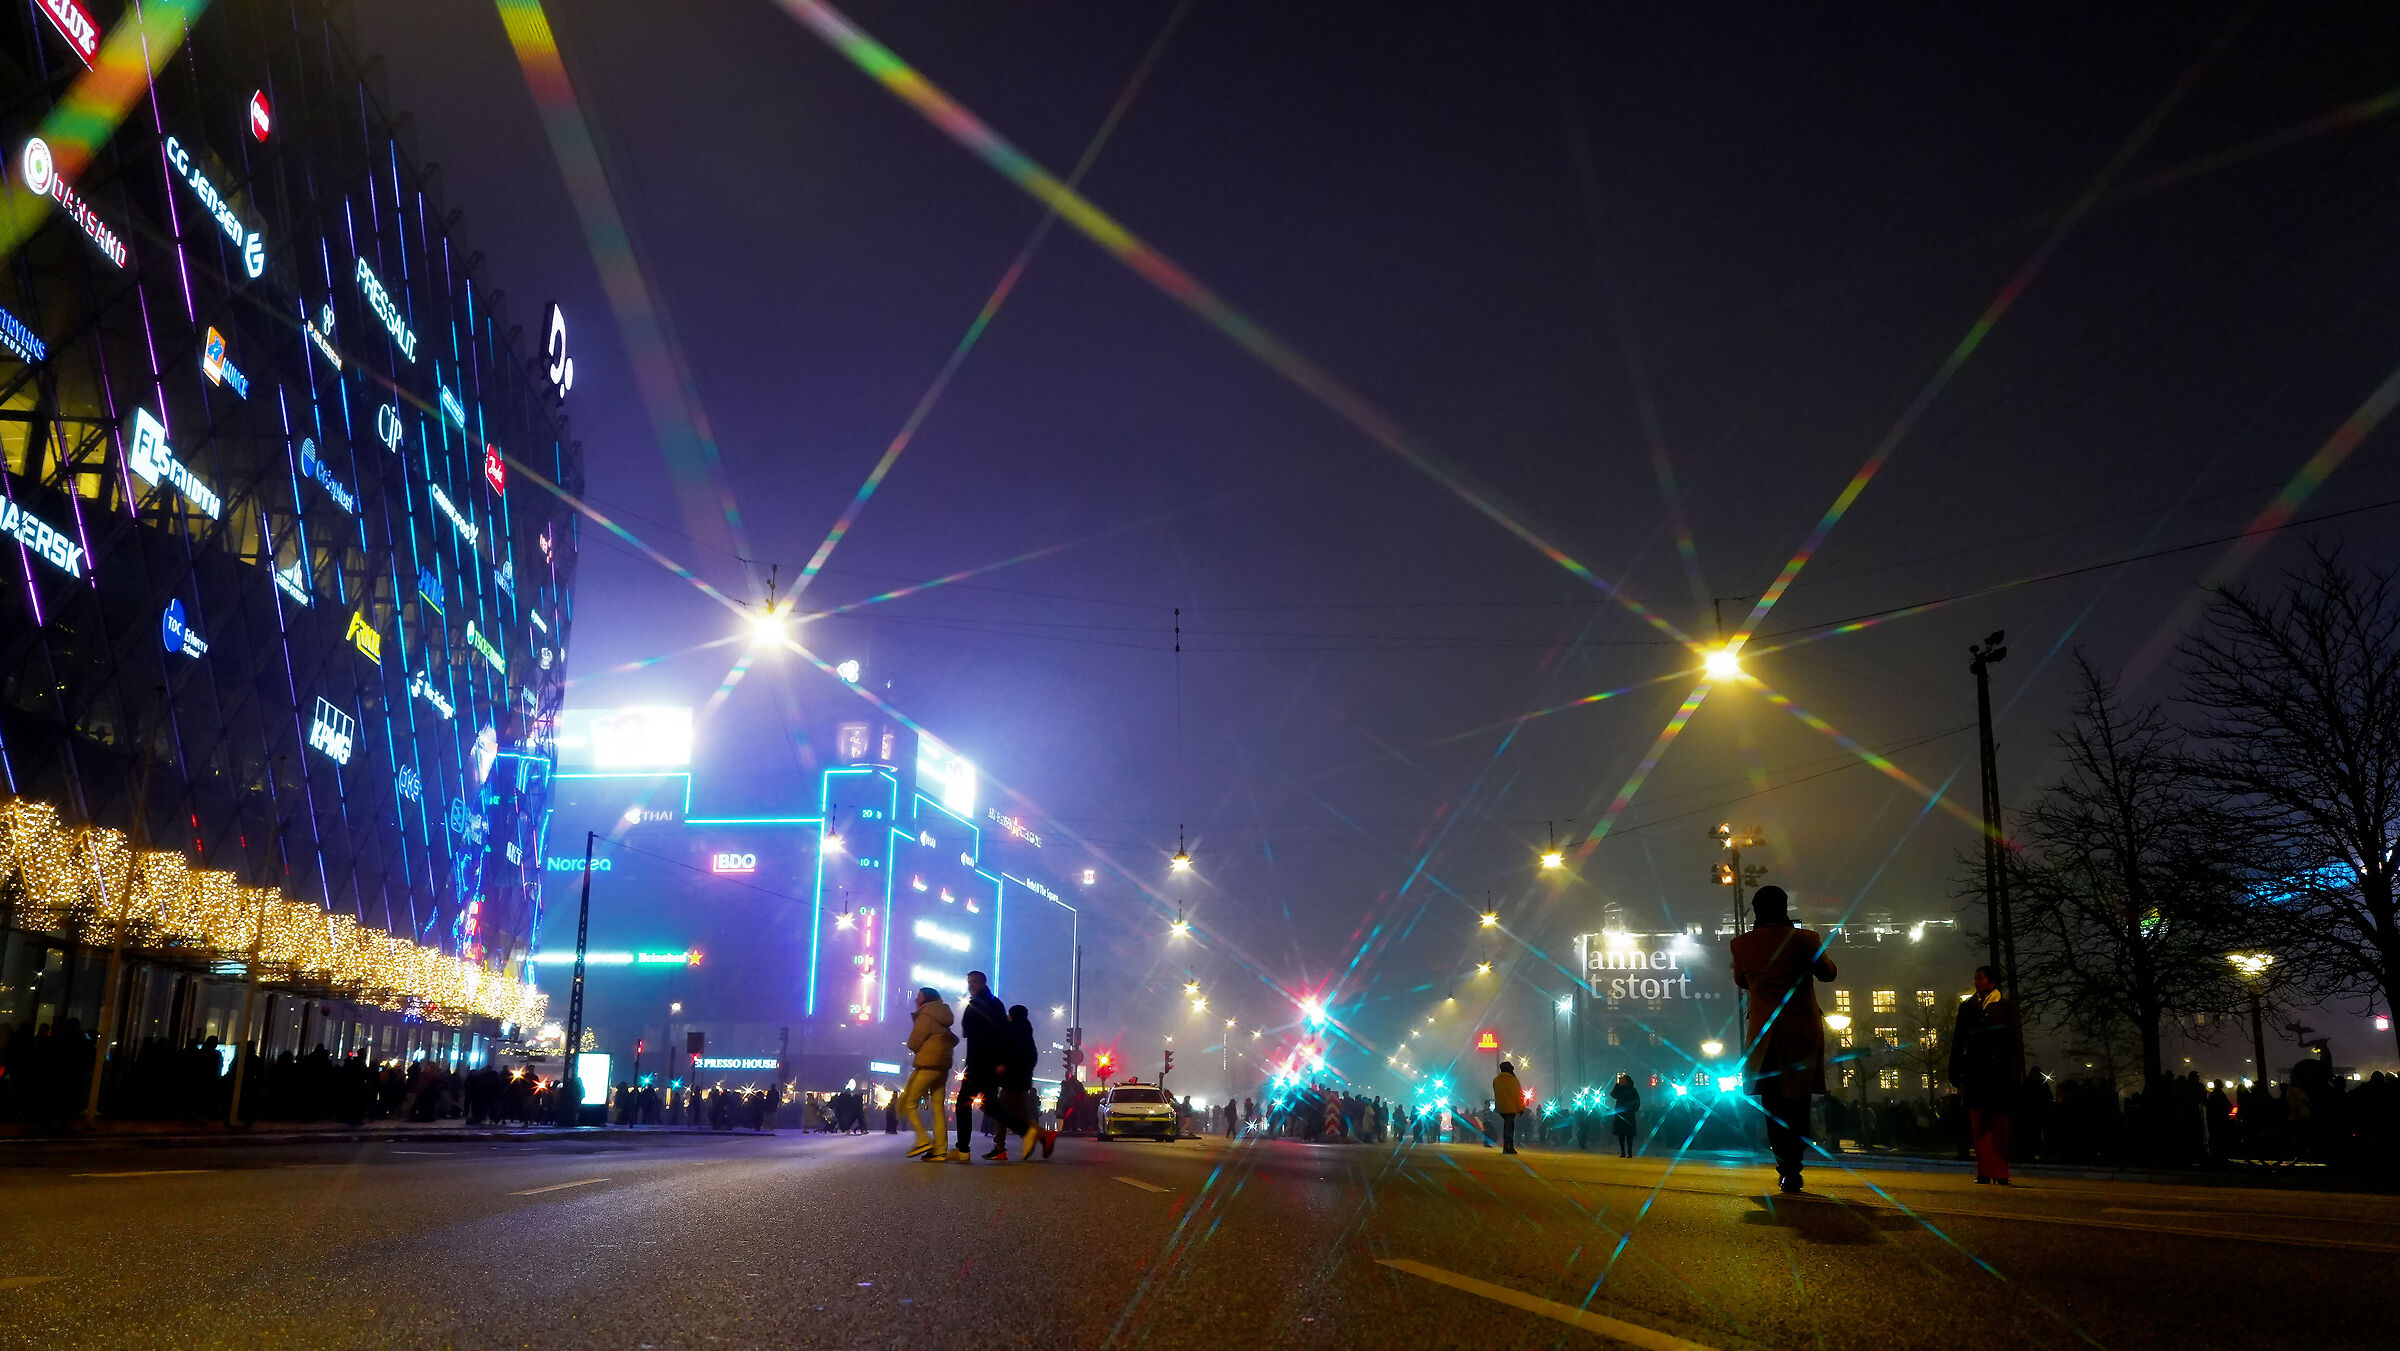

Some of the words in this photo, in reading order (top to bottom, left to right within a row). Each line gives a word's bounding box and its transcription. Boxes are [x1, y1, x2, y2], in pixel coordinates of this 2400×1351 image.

[189, 169, 243, 247] JENSEN
[309, 718, 351, 765] KPMG
[643, 810, 673, 821] THAI
[718, 853, 756, 869] BDO
[742, 1058, 778, 1069] HOUSE
